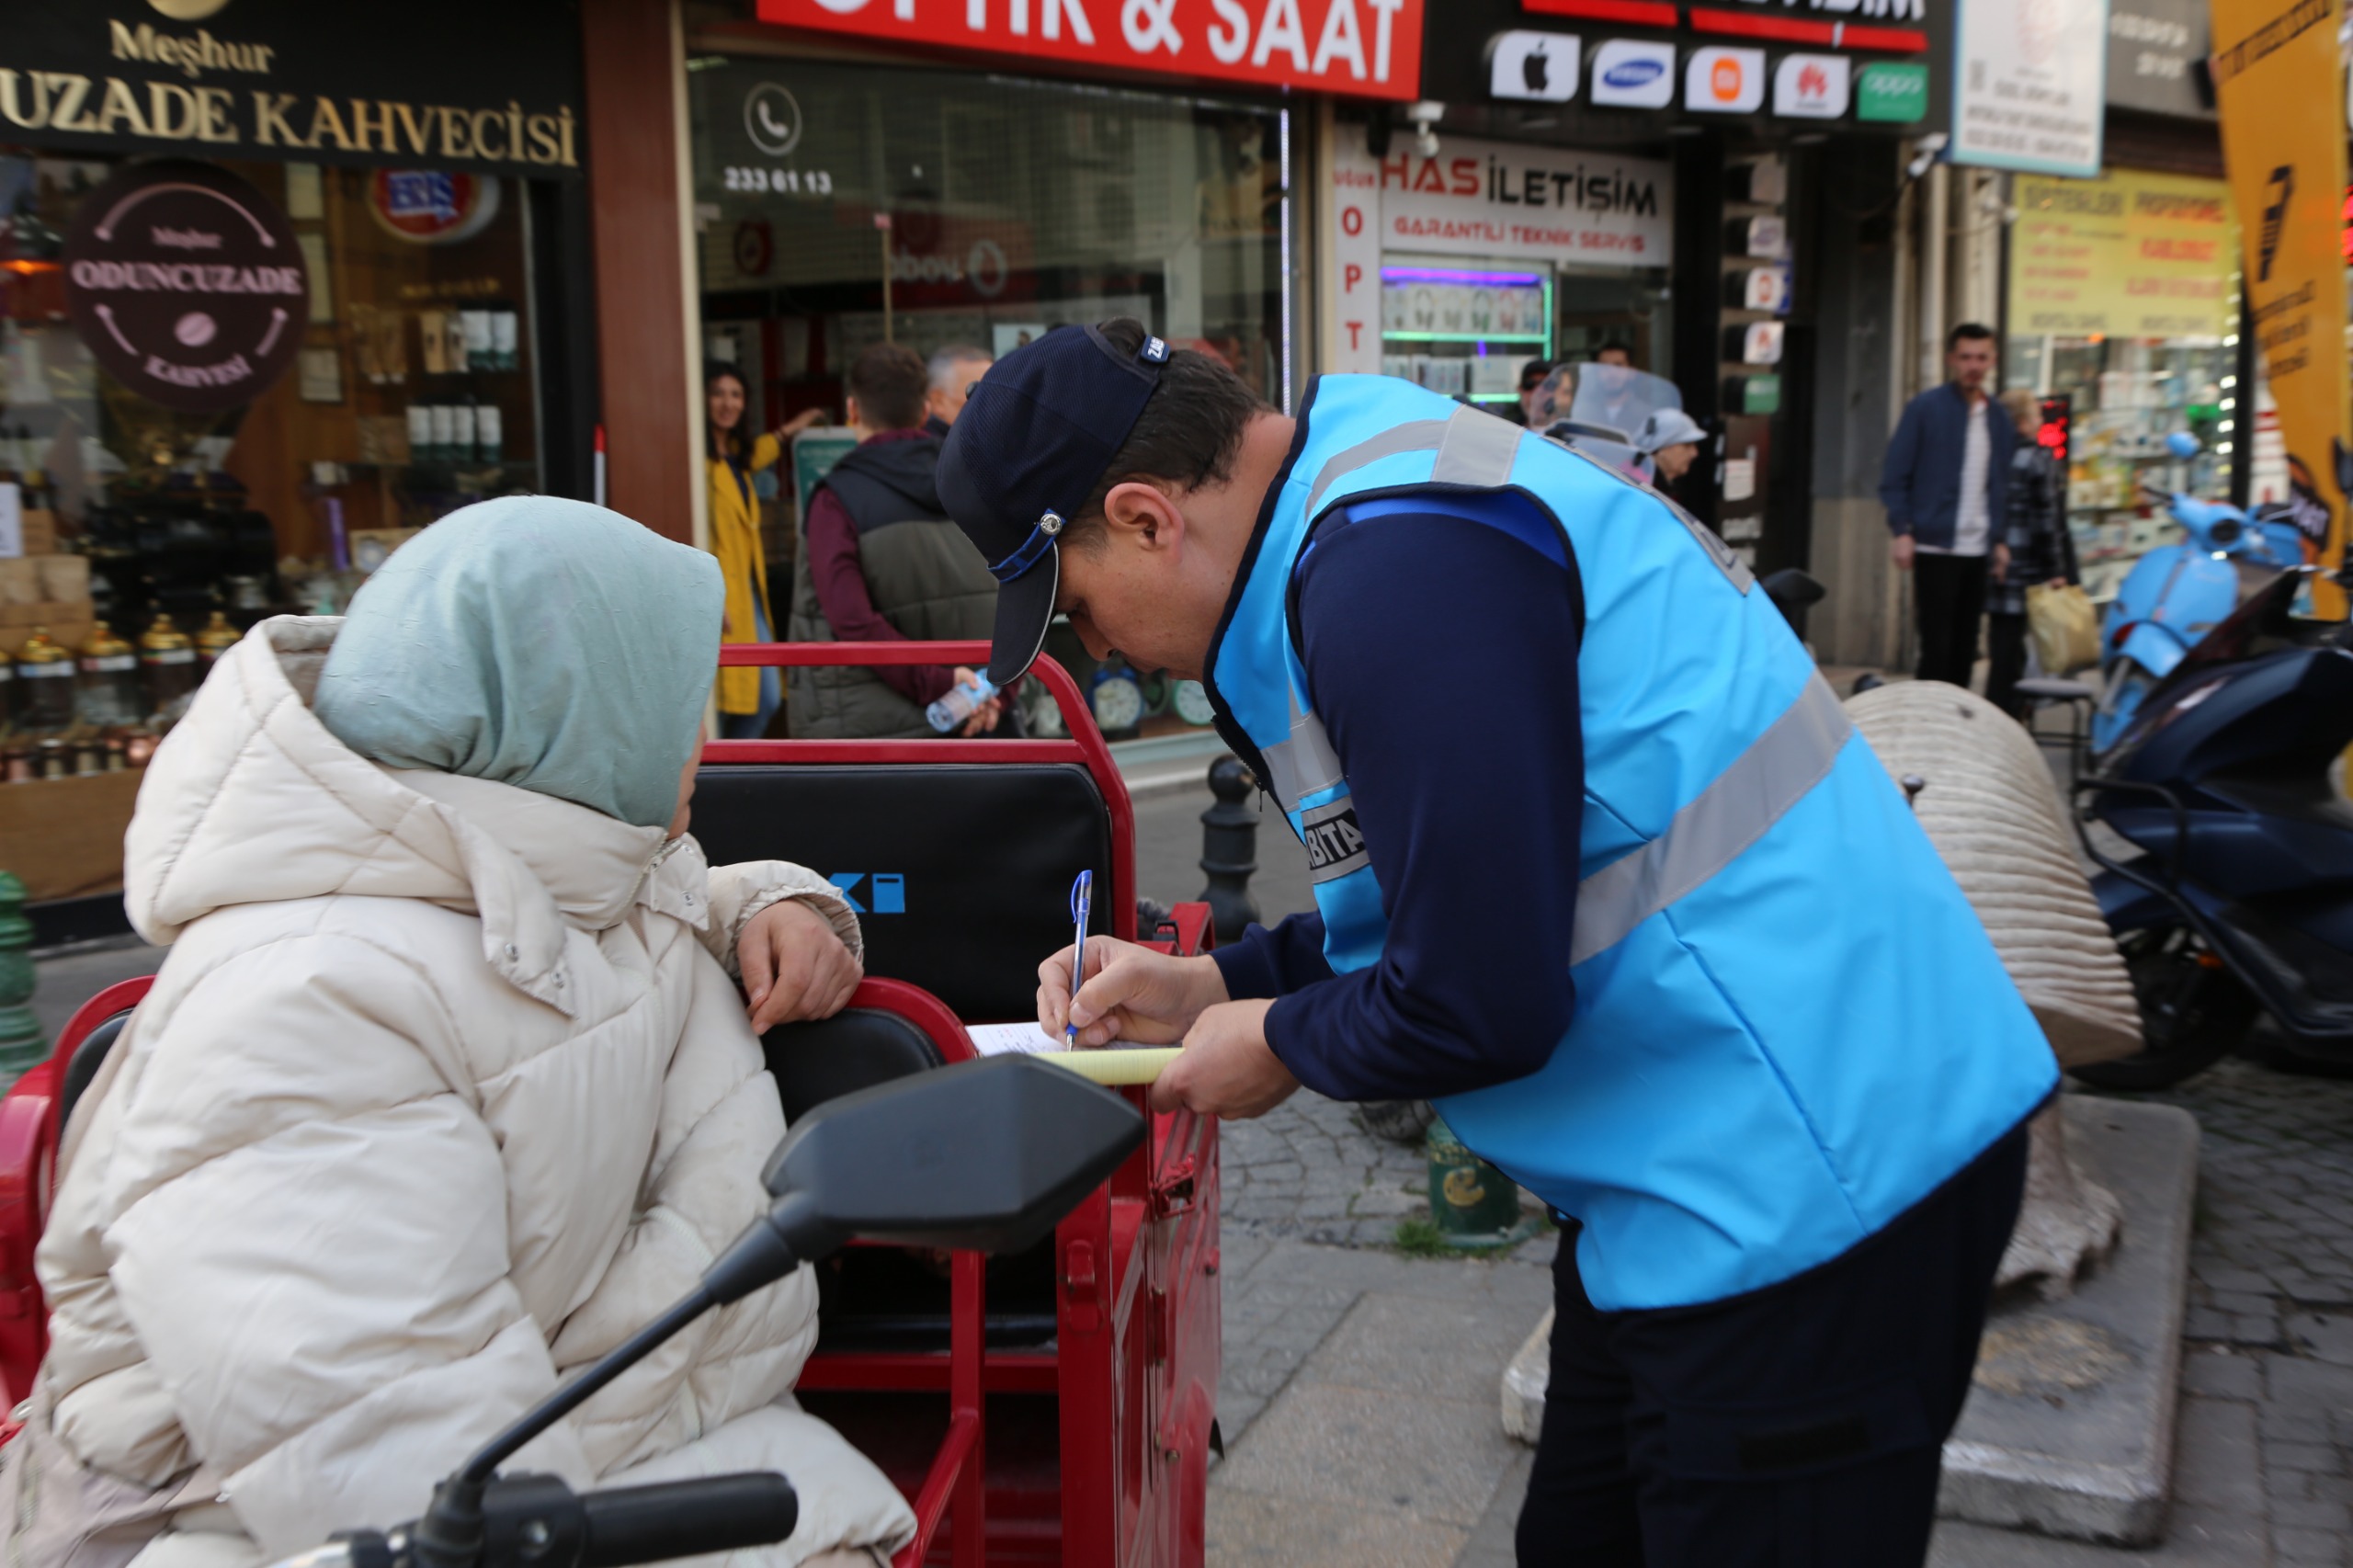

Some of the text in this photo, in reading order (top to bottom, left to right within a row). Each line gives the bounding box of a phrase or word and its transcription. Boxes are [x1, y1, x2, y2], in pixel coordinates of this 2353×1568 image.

[108, 17, 274, 78] Meşhur
[1206, 0, 1404, 84] SAAT
[0, 67, 579, 169] UZADE KAHVECİSİ
[1380, 152, 1659, 224] HAS İLETİŞİM
[71, 258, 302, 295] ODUNCUZADE
[1305, 818, 1364, 869] BITA
